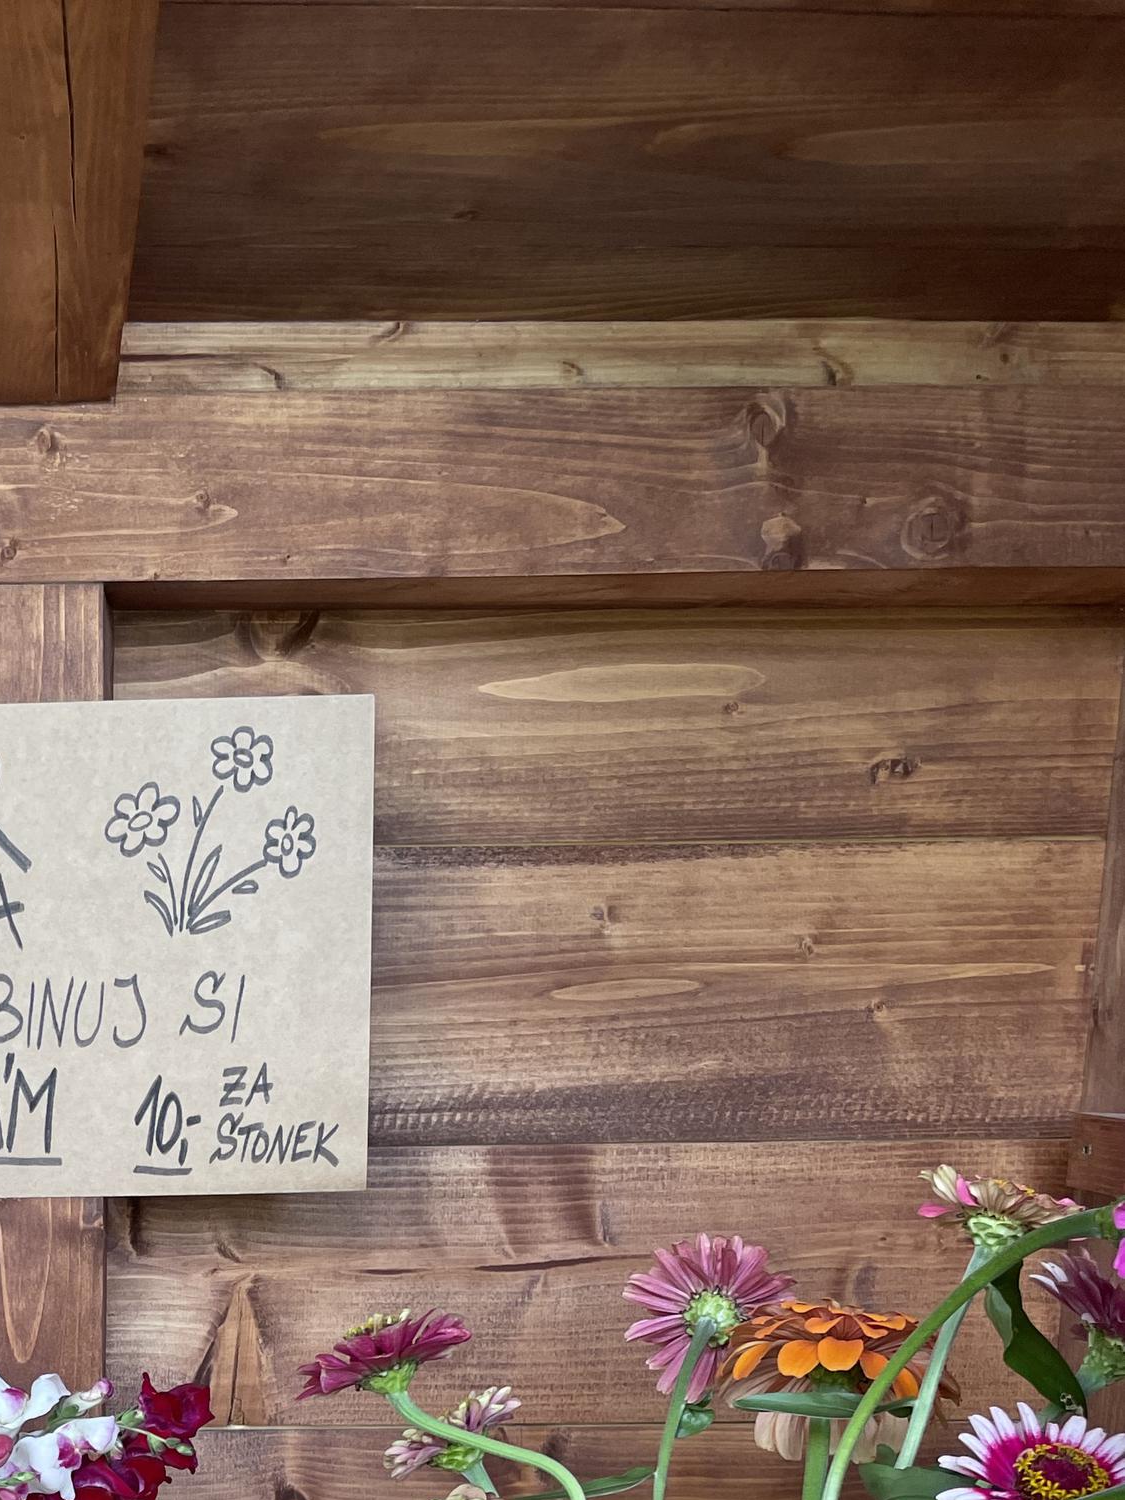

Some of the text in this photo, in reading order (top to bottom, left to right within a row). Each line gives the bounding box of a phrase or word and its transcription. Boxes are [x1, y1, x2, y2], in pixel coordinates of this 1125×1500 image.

[179, 971, 247, 1044] SI
[219, 1062, 274, 1107] ZA
[209, 1112, 340, 1168] STONEK
